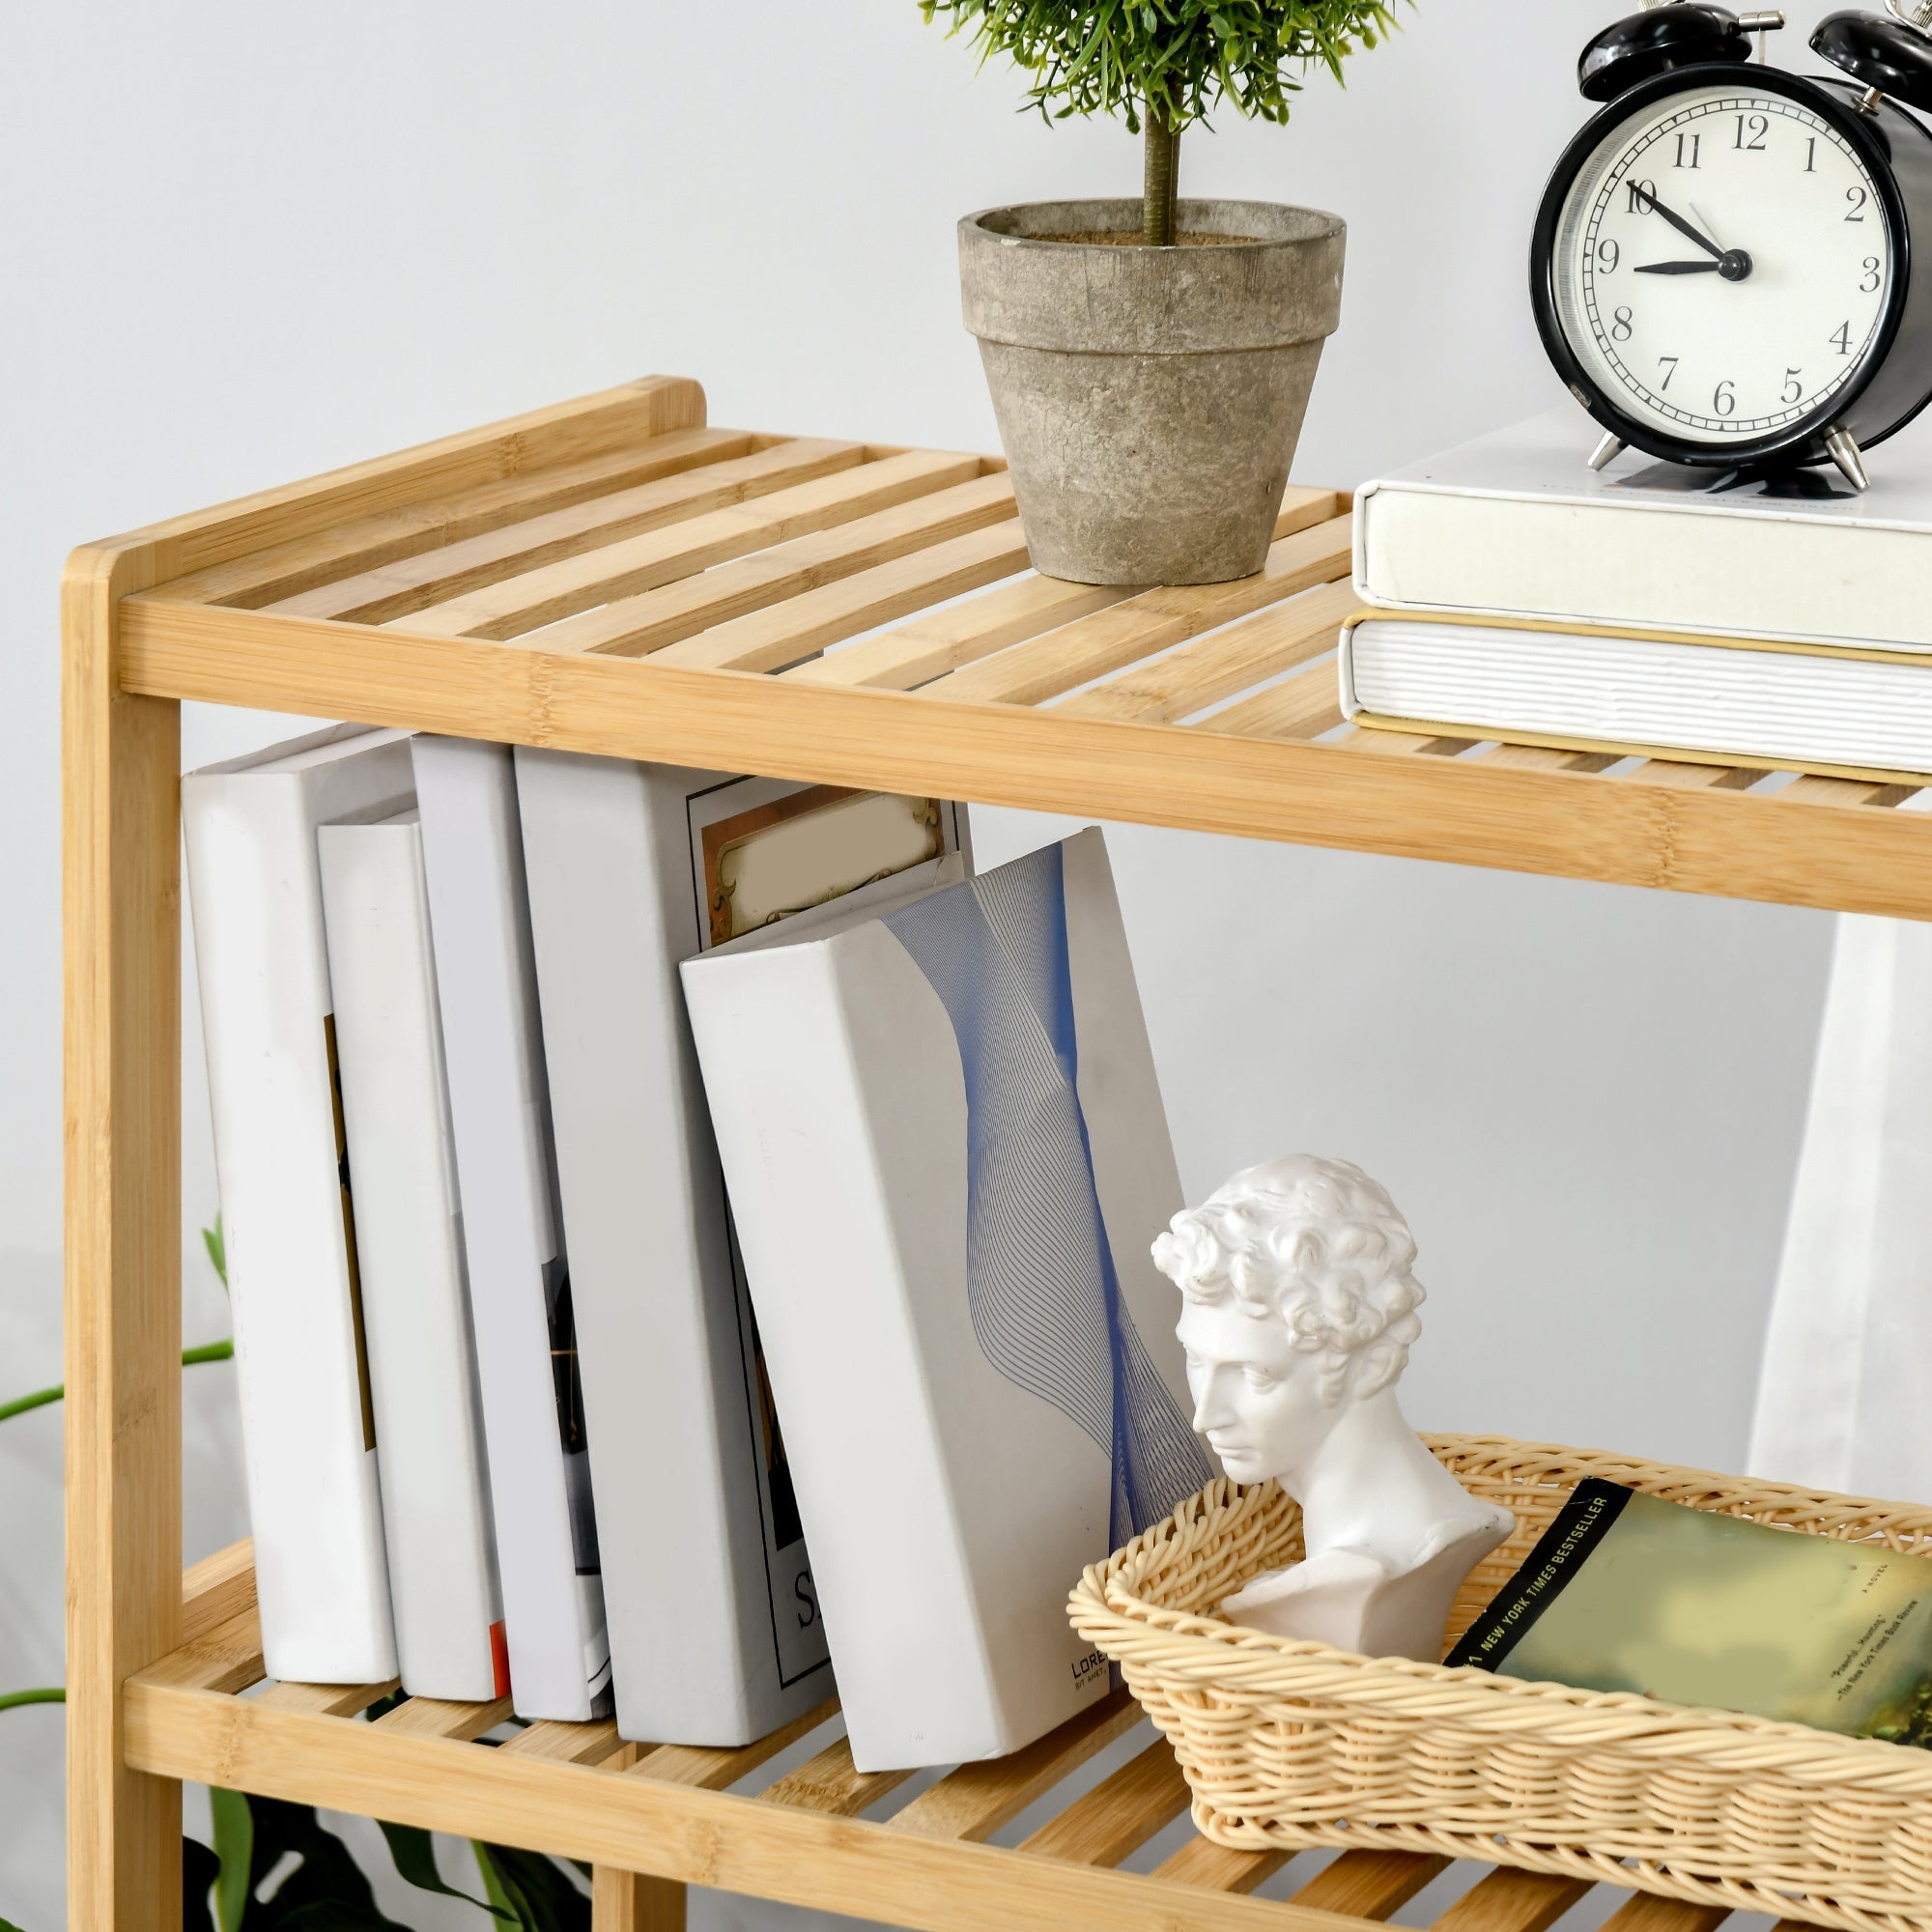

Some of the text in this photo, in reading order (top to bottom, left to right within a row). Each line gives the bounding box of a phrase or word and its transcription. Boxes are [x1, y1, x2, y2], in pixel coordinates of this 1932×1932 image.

[1732, 114, 1768, 150] 12
[1671, 133, 1701, 169] 11
[1803, 137, 1817, 172] 1
[1625, 178, 1657, 214] 10
[1844, 186, 1867, 222] 2
[1598, 239, 1620, 273] 9
[1859, 256, 1881, 293] 3
[1611, 306, 1634, 342] 8
[1829, 320, 1854, 355] 4
[1658, 356, 1680, 391] 7
[1780, 367, 1803, 404] 5
[1714, 380, 1736, 416] 6
[1480, 1625, 1505, 1652] NEW
[1502, 1597, 1530, 1626] YORK
[1525, 1563, 1557, 1597] TIMES
[1550, 1496, 1607, 1565] BESTSELLER
[1867, 1564, 1889, 1586] NOVEL
[795, 1568, 822, 1631] S
[1848, 1669, 1863, 1684] New
[1860, 1655, 1875, 1668] York
[1870, 1636, 1890, 1654] Times
[1885, 1621, 1901, 1636] Book
[1896, 1600, 1918, 1621] Review
[1071, 1650, 1108, 1679] LORE
